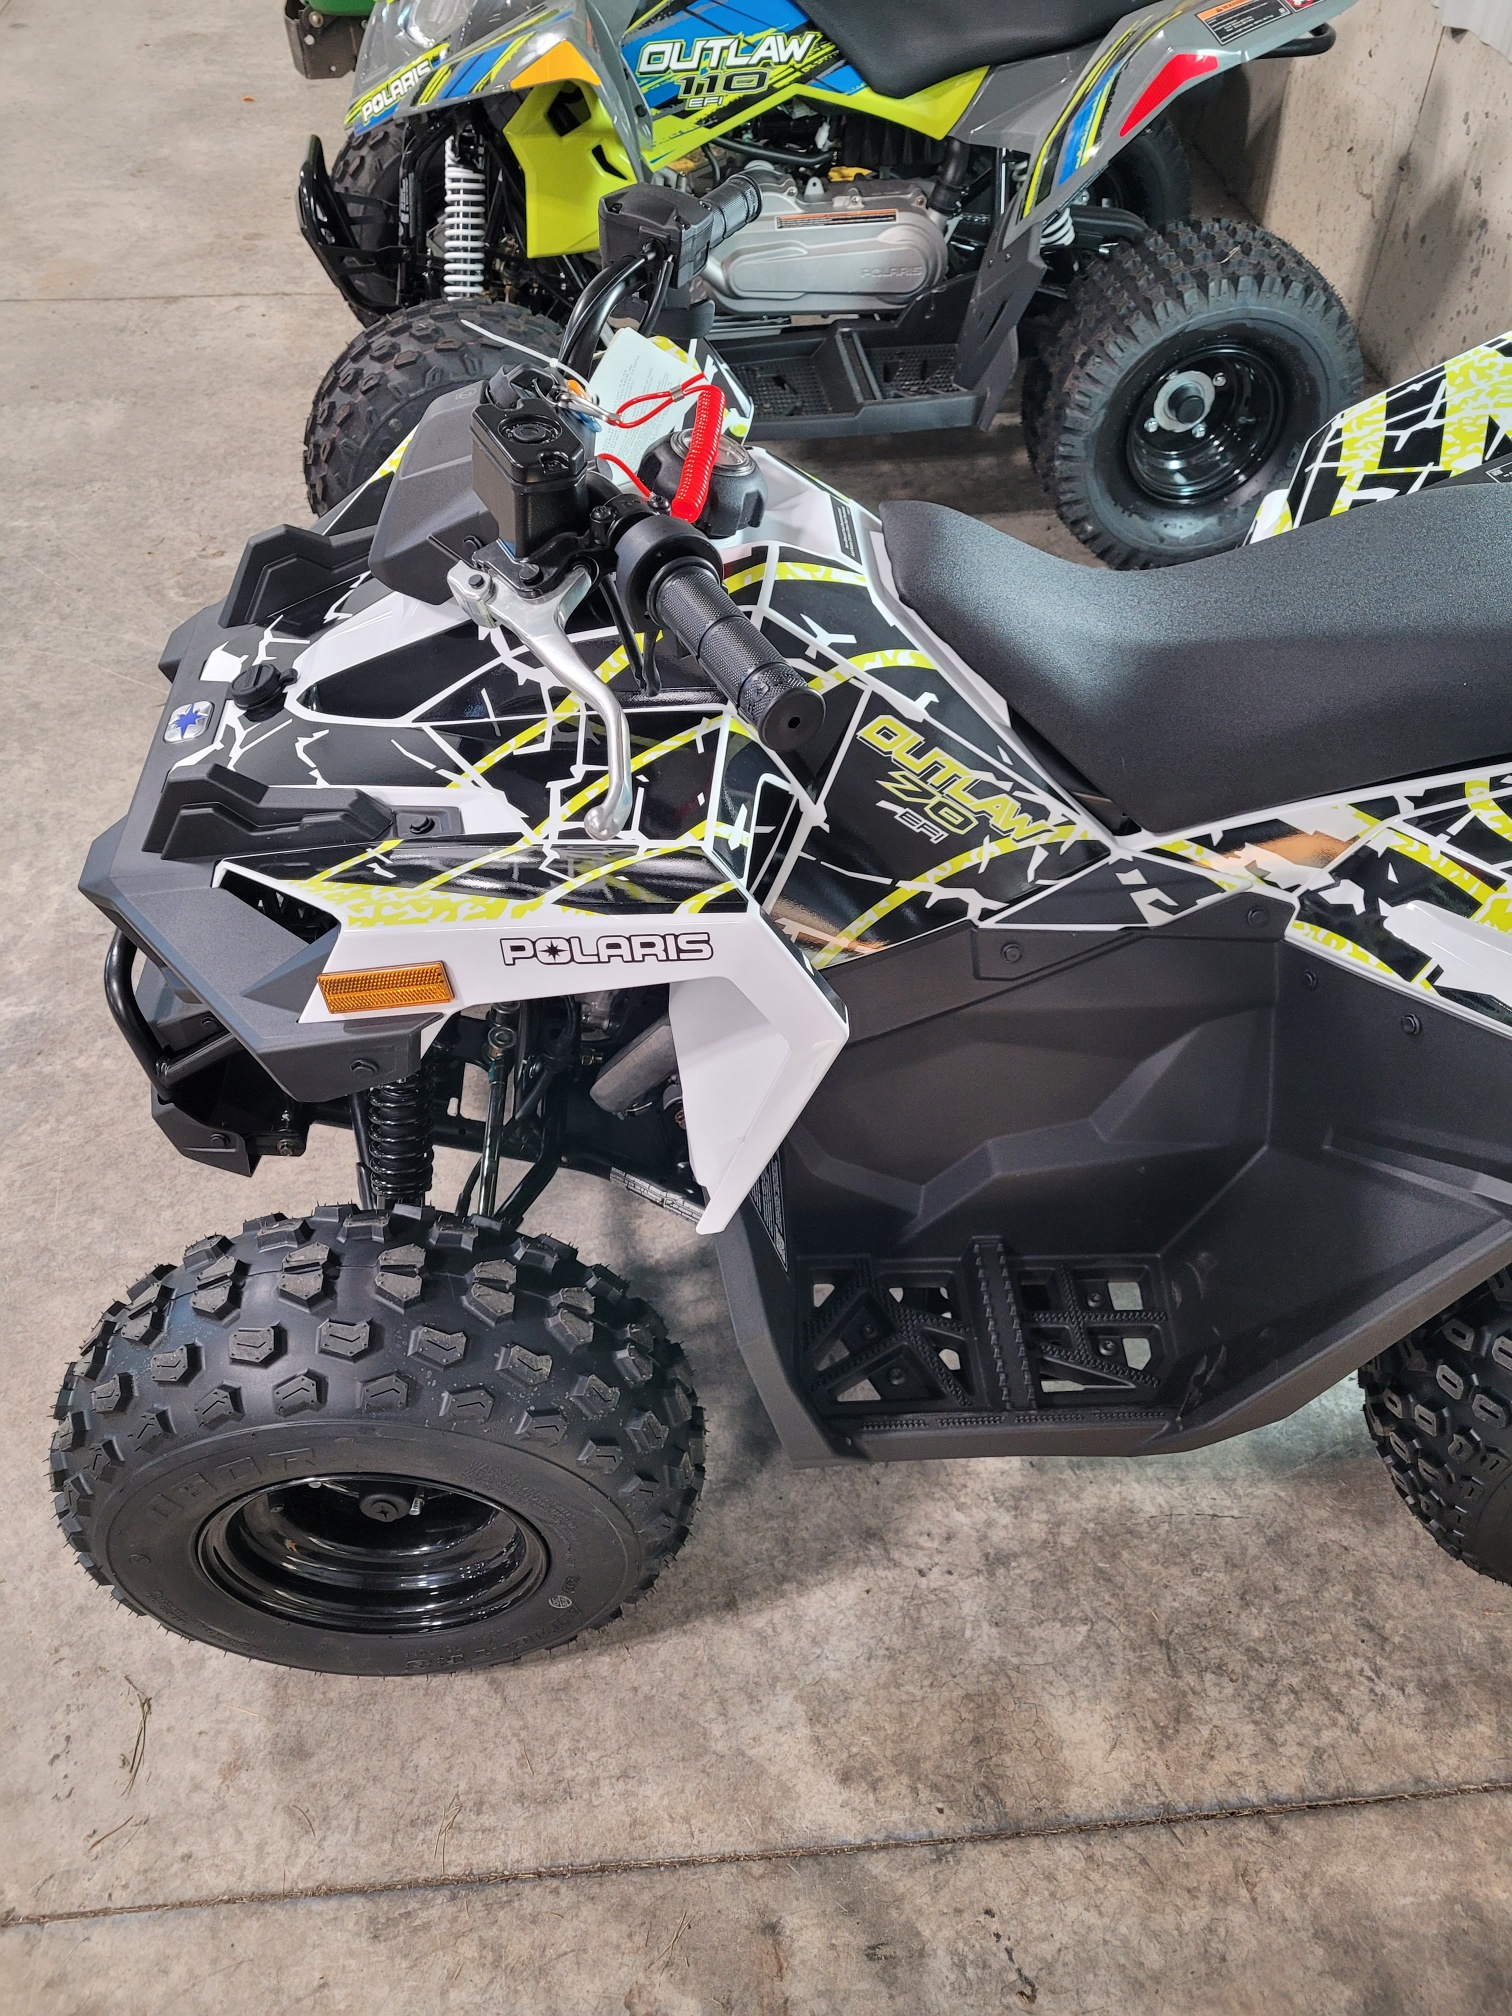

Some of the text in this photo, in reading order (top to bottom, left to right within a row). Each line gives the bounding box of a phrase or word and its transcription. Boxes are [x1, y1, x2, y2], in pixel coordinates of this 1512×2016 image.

[637, 32, 819, 75] OUTLAW
[361, 59, 432, 123] POLARIS
[676, 69, 769, 97] 110
[688, 96, 723, 109] EFI
[860, 265, 923, 279] POLARIS
[857, 715, 1055, 843] OUTLAW
[500, 932, 714, 966] POLARIS
